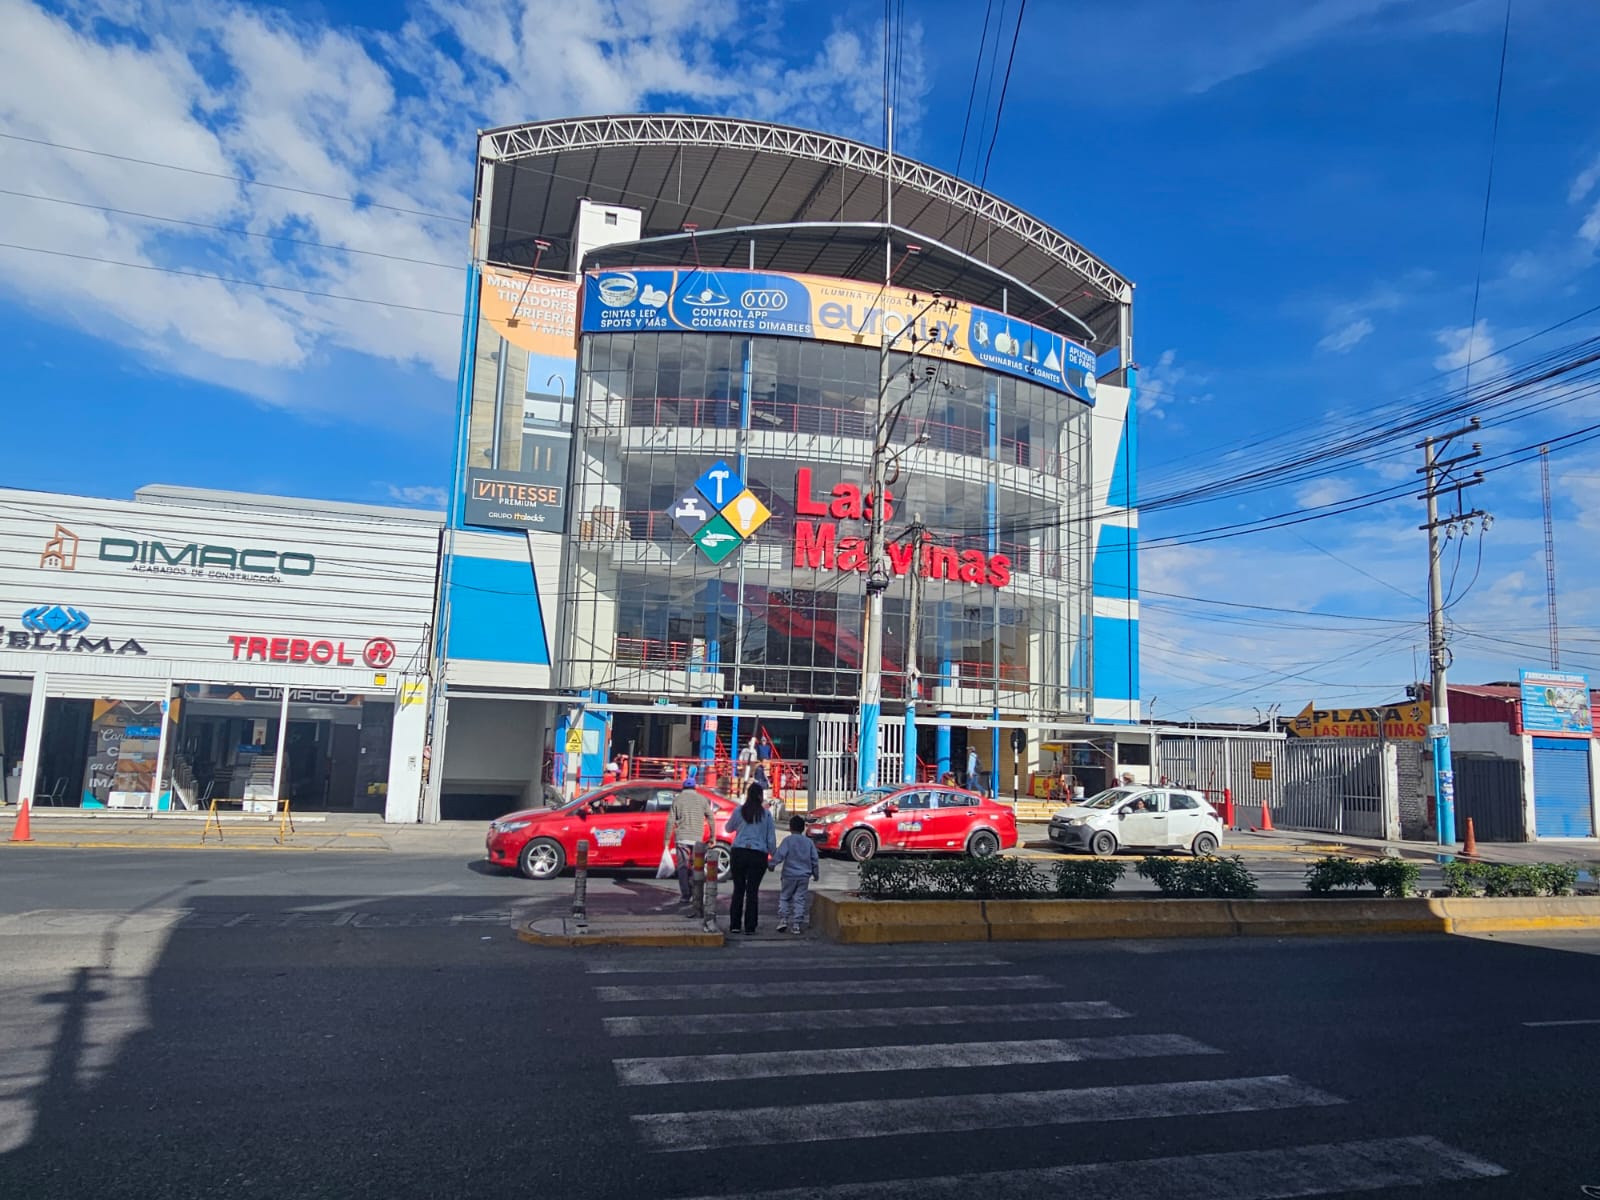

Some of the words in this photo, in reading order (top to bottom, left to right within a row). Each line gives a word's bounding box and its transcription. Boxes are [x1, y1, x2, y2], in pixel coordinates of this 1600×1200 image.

[487, 275, 576, 300] MANILLONES
[498, 290, 576, 313] TIRADORES
[905, 300, 924, 310] CN
[601, 309, 636, 319] CINTAS
[639, 309, 657, 318] LED
[692, 308, 746, 319] CONTROL
[747, 310, 769, 320] APP
[600, 319, 632, 328] SPOTS
[635, 319, 642, 327] Y
[691, 318, 755, 329] COLGANTES
[759, 321, 811, 334] DIMABLES
[980, 353, 1023, 370] LUMINARIAS
[479, 481, 557, 503] VITTESSE
[796, 466, 895, 523] Las
[498, 498, 537, 508] PREMIUM
[488, 511, 513, 520] GRUPO
[99, 537, 316, 576] DIMACO
[794, 520, 1011, 588] Mavinas
[132, 564, 187, 575] ACABADOS
[191, 569, 205, 577] DE
[0, 626, 148, 656] ELIMA
[228, 635, 355, 667] TREBOL
[255, 687, 348, 703] DIMACO
[1313, 708, 1403, 723] PLAYA
[1314, 725, 1340, 738] LAS
